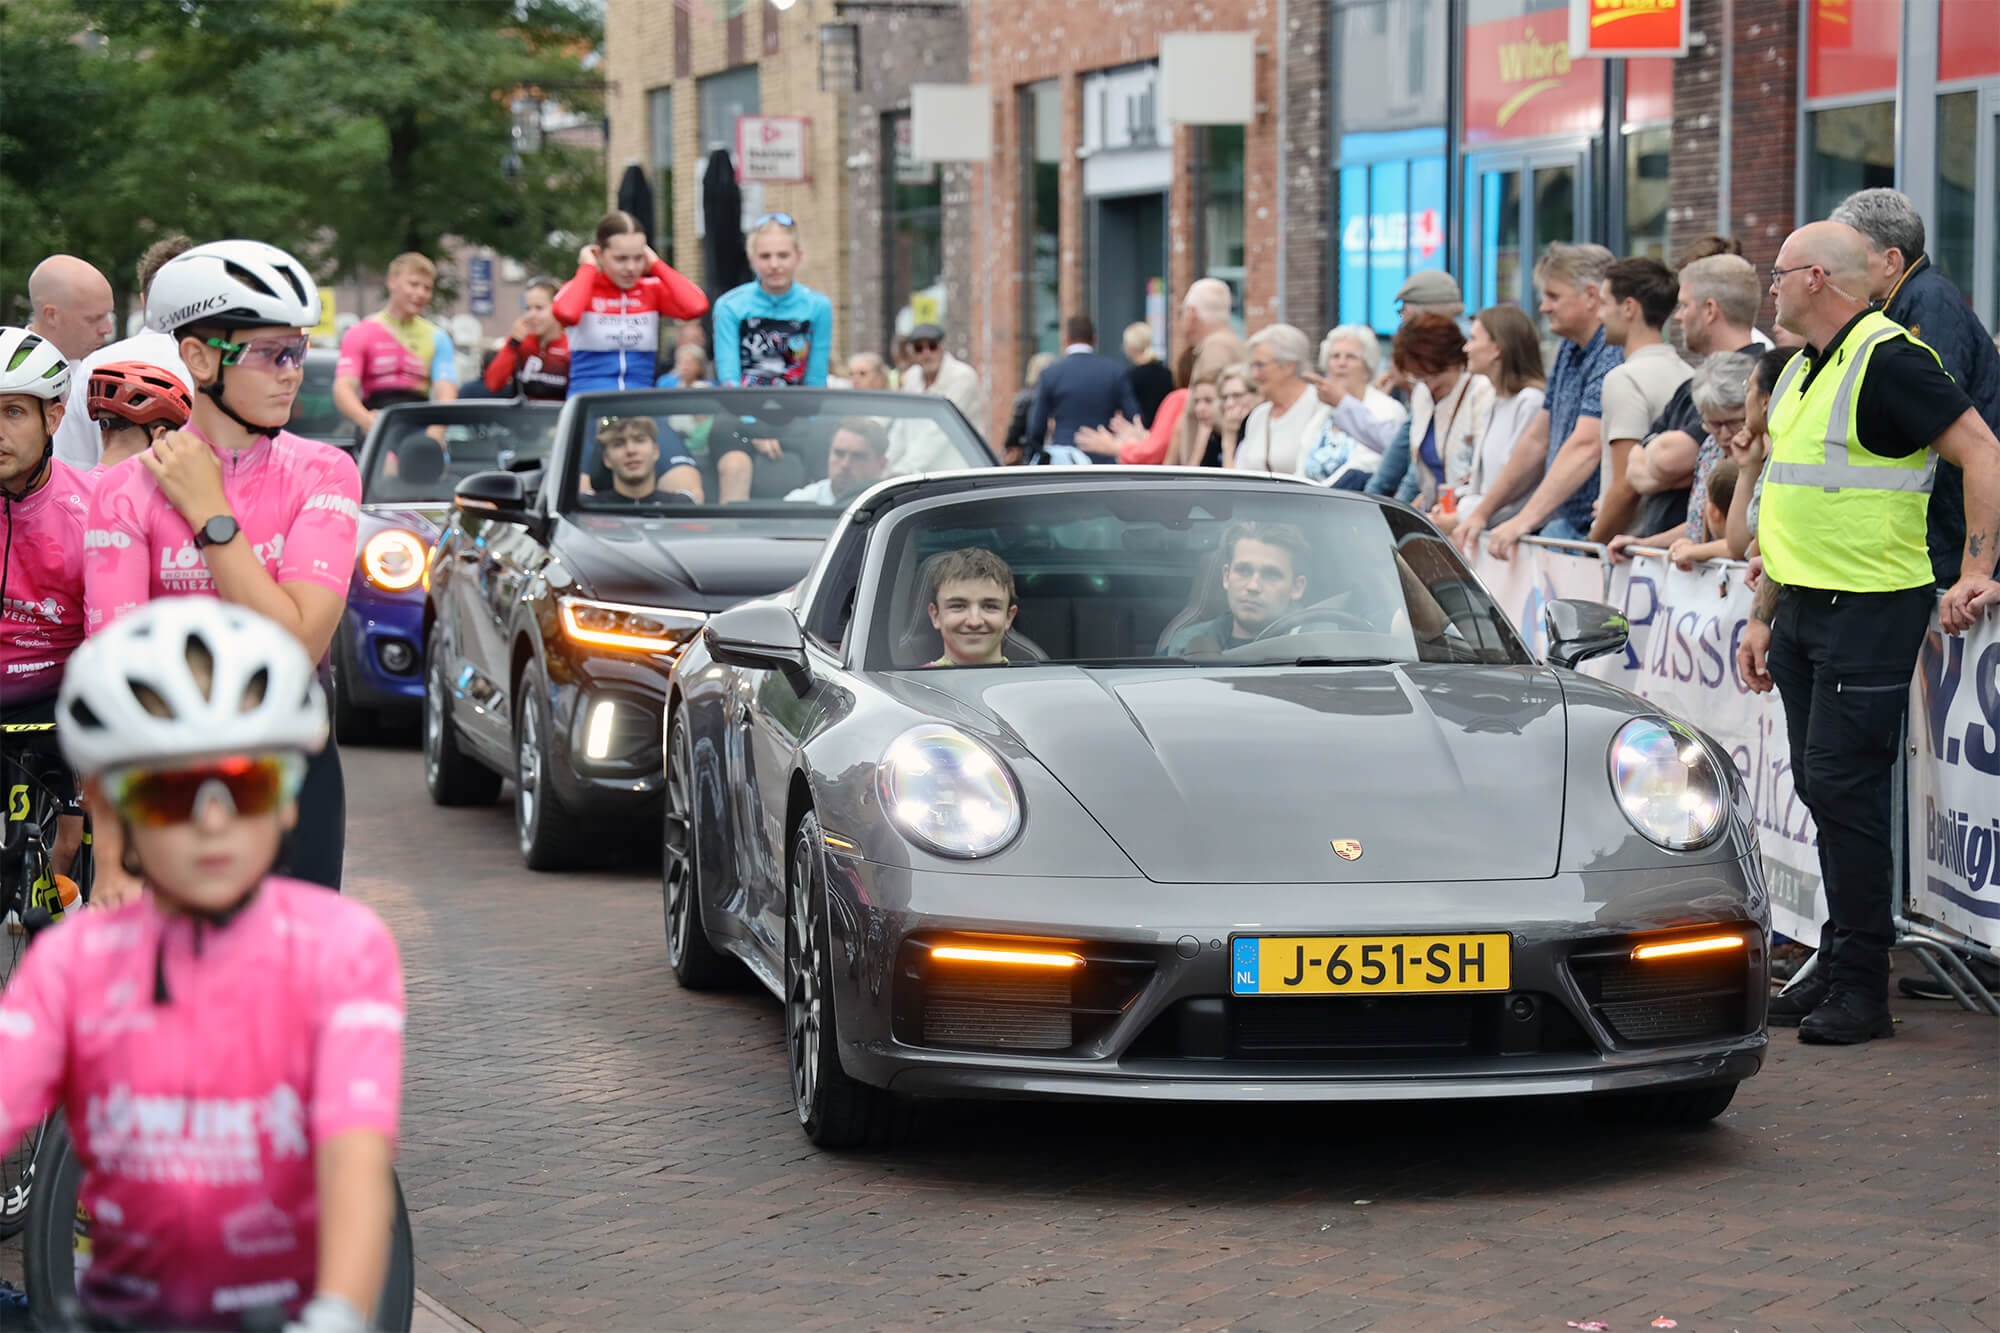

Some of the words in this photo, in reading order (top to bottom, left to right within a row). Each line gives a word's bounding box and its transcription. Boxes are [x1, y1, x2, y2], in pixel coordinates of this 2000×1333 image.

[159, 292, 230, 329] S-WORKS
[1237, 971, 1256, 984] NL
[1284, 942, 1485, 986] J-651-SH
